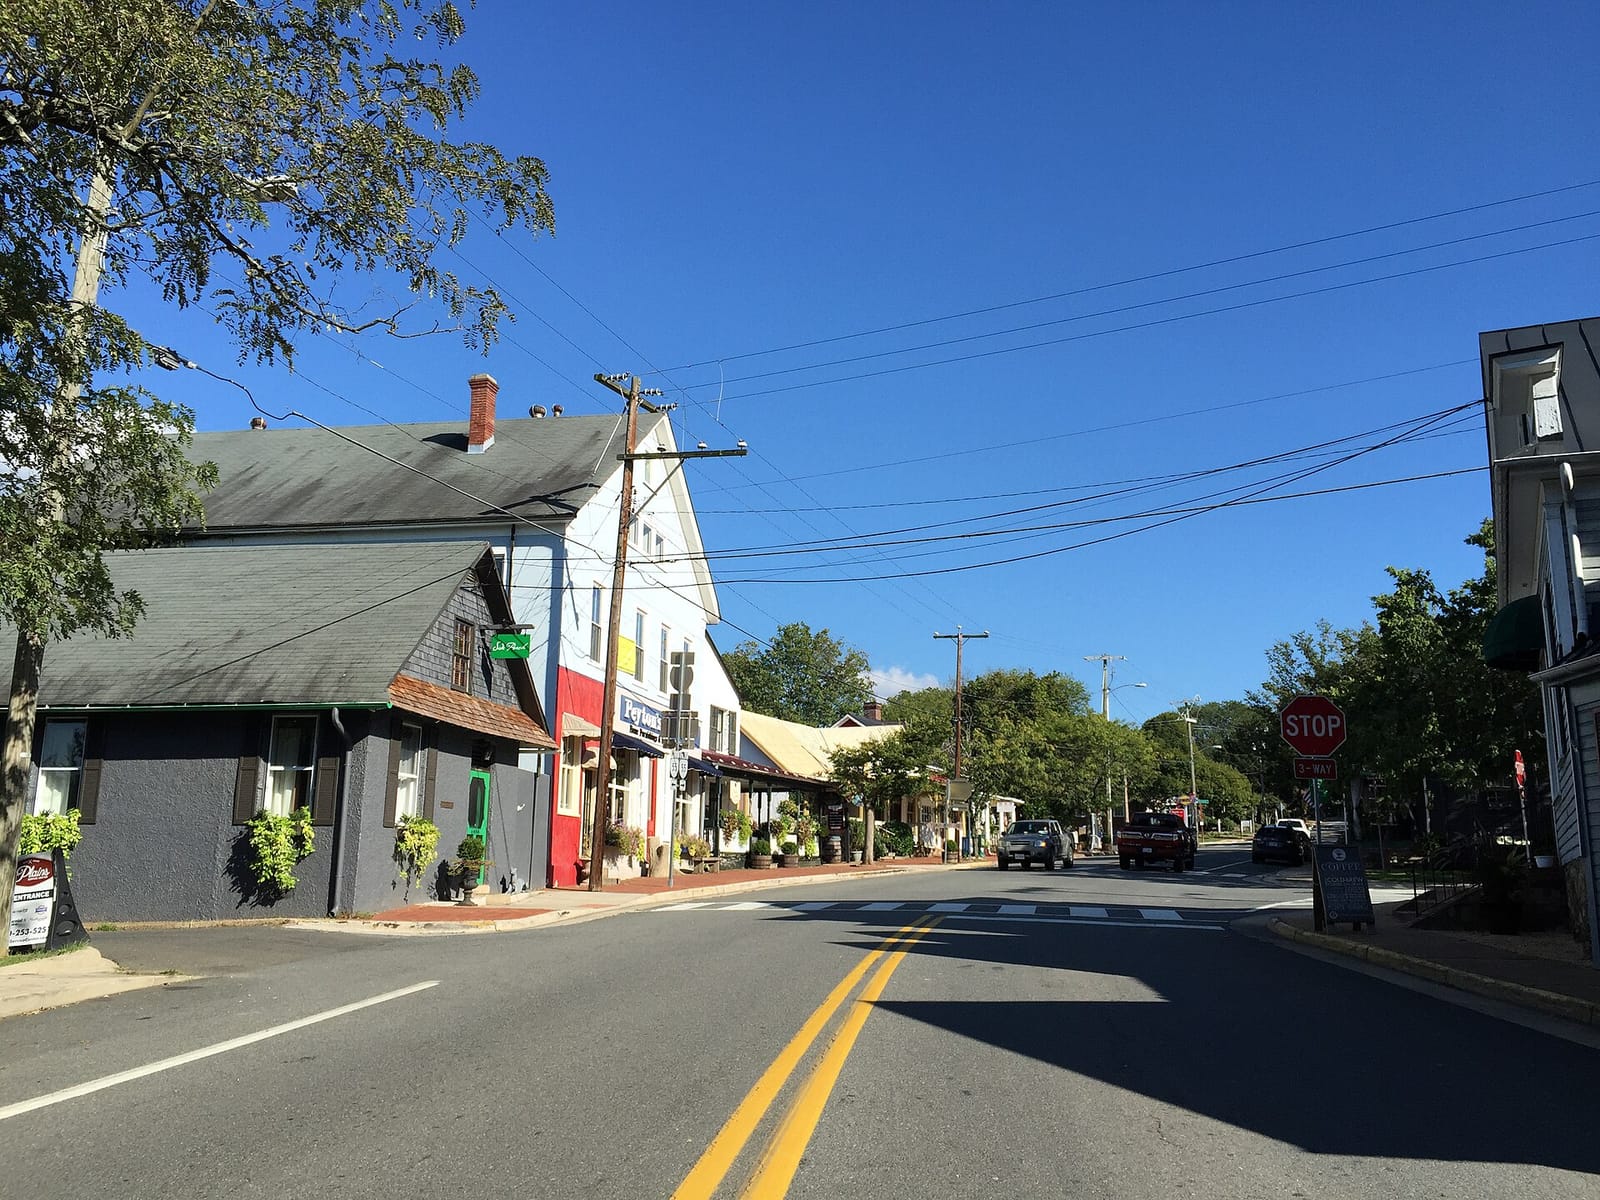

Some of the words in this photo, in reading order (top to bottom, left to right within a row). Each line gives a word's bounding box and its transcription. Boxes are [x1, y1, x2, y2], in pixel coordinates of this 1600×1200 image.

[1286, 714, 1341, 737] STOP
[1299, 763, 1332, 774] 3-WAY
[16, 865, 50, 882] Plains
[14, 891, 50, 901] ENTRANCE
